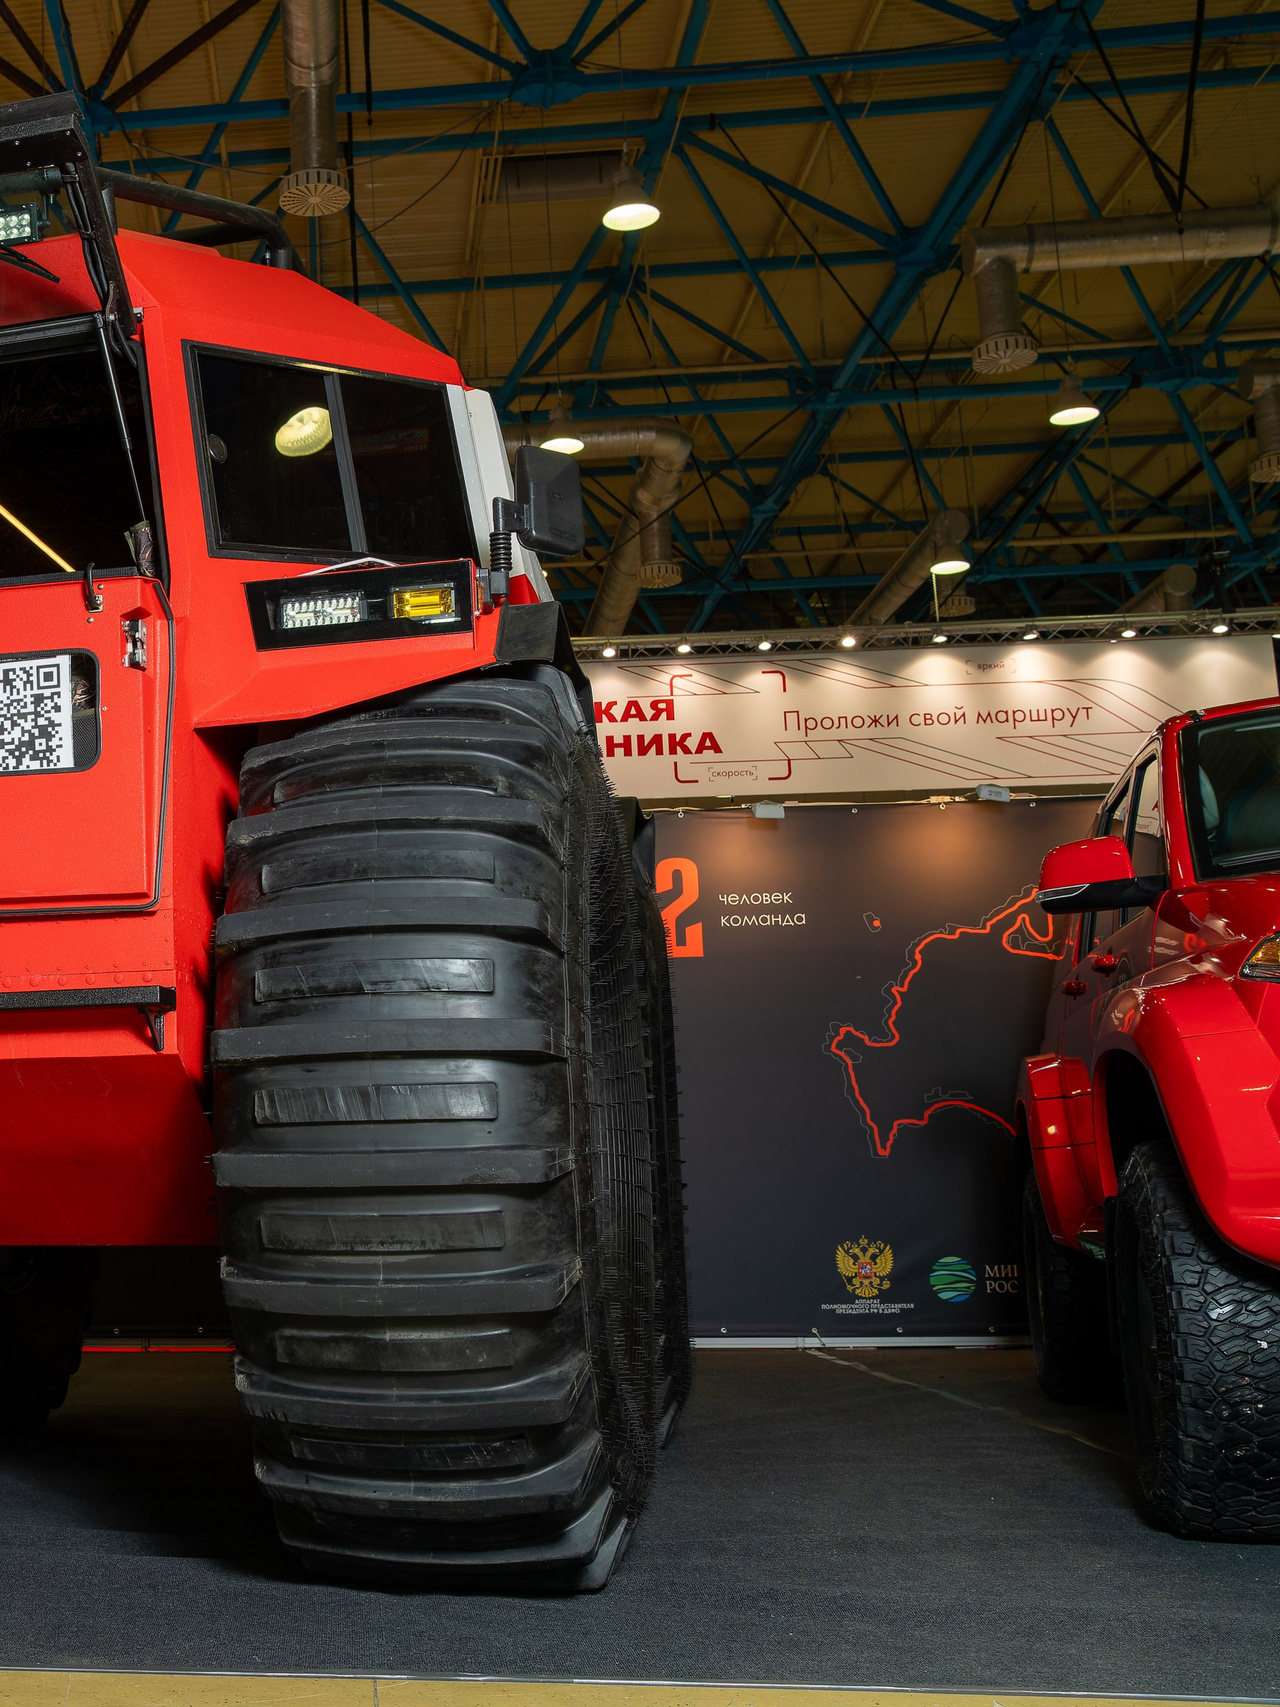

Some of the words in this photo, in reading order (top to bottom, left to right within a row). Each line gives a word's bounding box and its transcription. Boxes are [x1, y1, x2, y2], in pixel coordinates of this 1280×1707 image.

[977, 660, 1005, 670] яркий
[783, 710, 899, 737] Проложи
[909, 706, 967, 727] свой
[976, 706, 1093, 729] маршрут
[600, 732, 723, 757] НИКА
[711, 769, 754, 779] скорость
[719, 891, 793, 905] человек
[720, 913, 806, 927] команда
